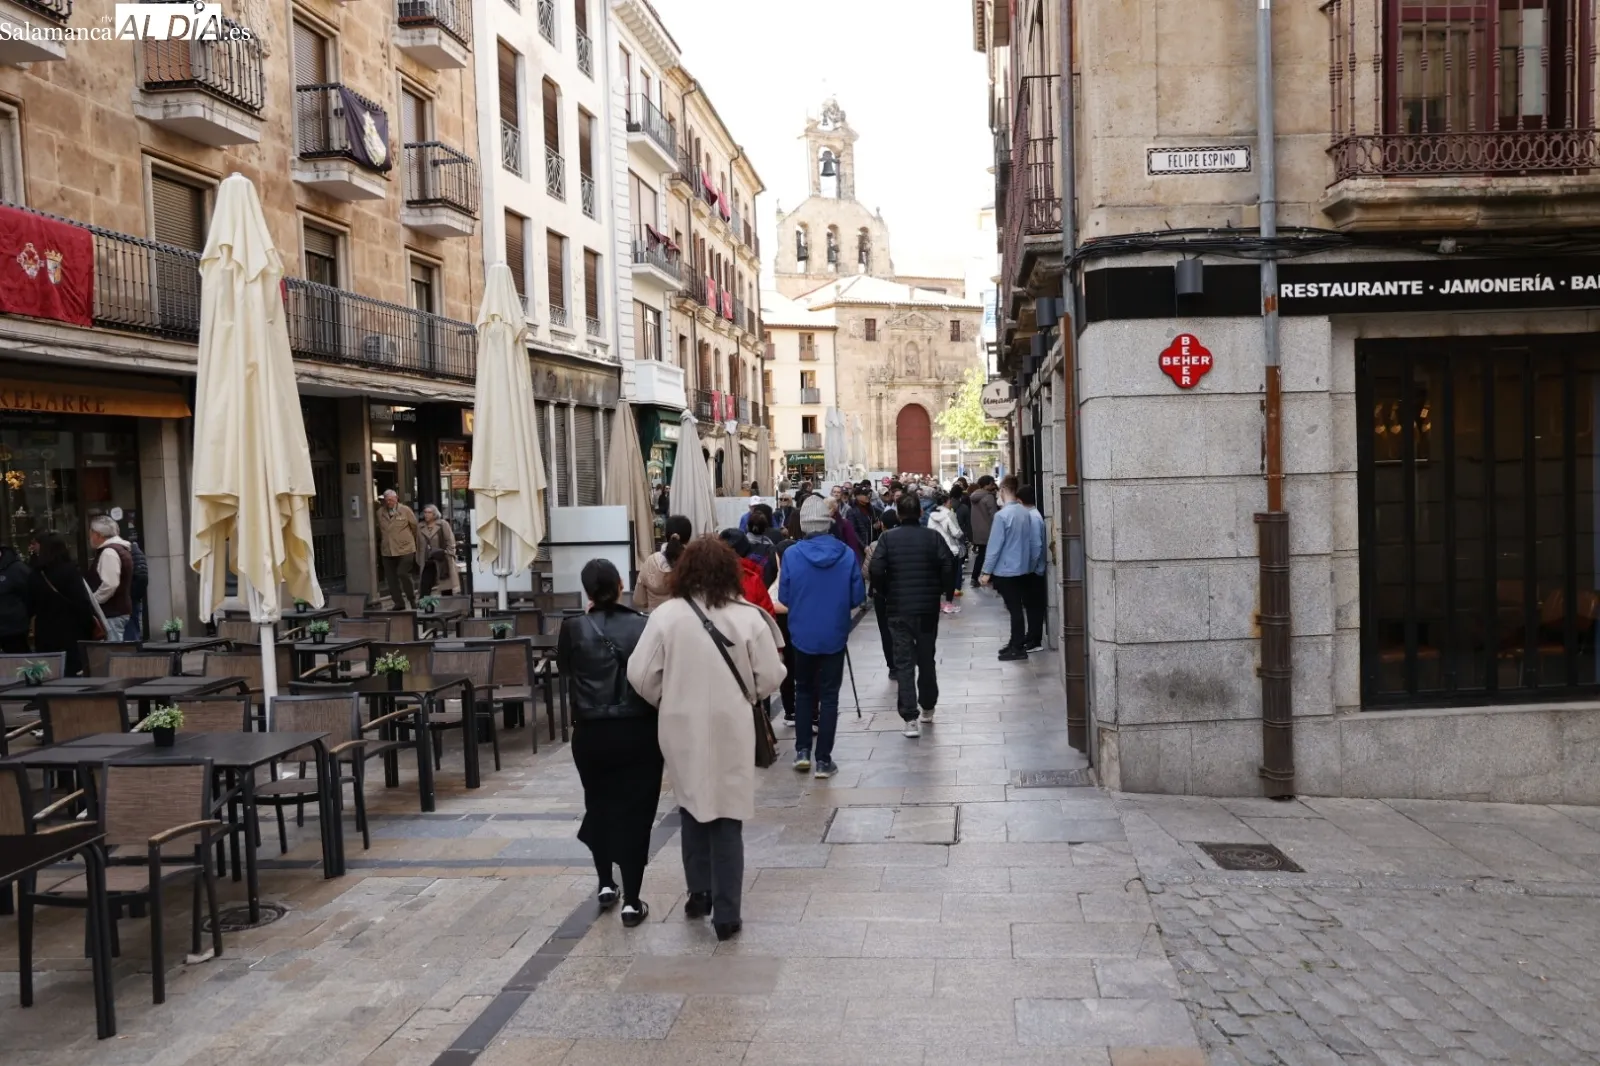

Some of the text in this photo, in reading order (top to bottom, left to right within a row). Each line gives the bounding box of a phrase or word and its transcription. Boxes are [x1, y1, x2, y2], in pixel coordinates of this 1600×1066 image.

[1168, 153, 1236, 168] FELIPE ESPINO
[1280, 274, 1600, 297] RESTAURANTE JAMONERÍA BA
[1162, 355, 1210, 366] BEHER
[1181, 336, 1190, 385] BEHER
